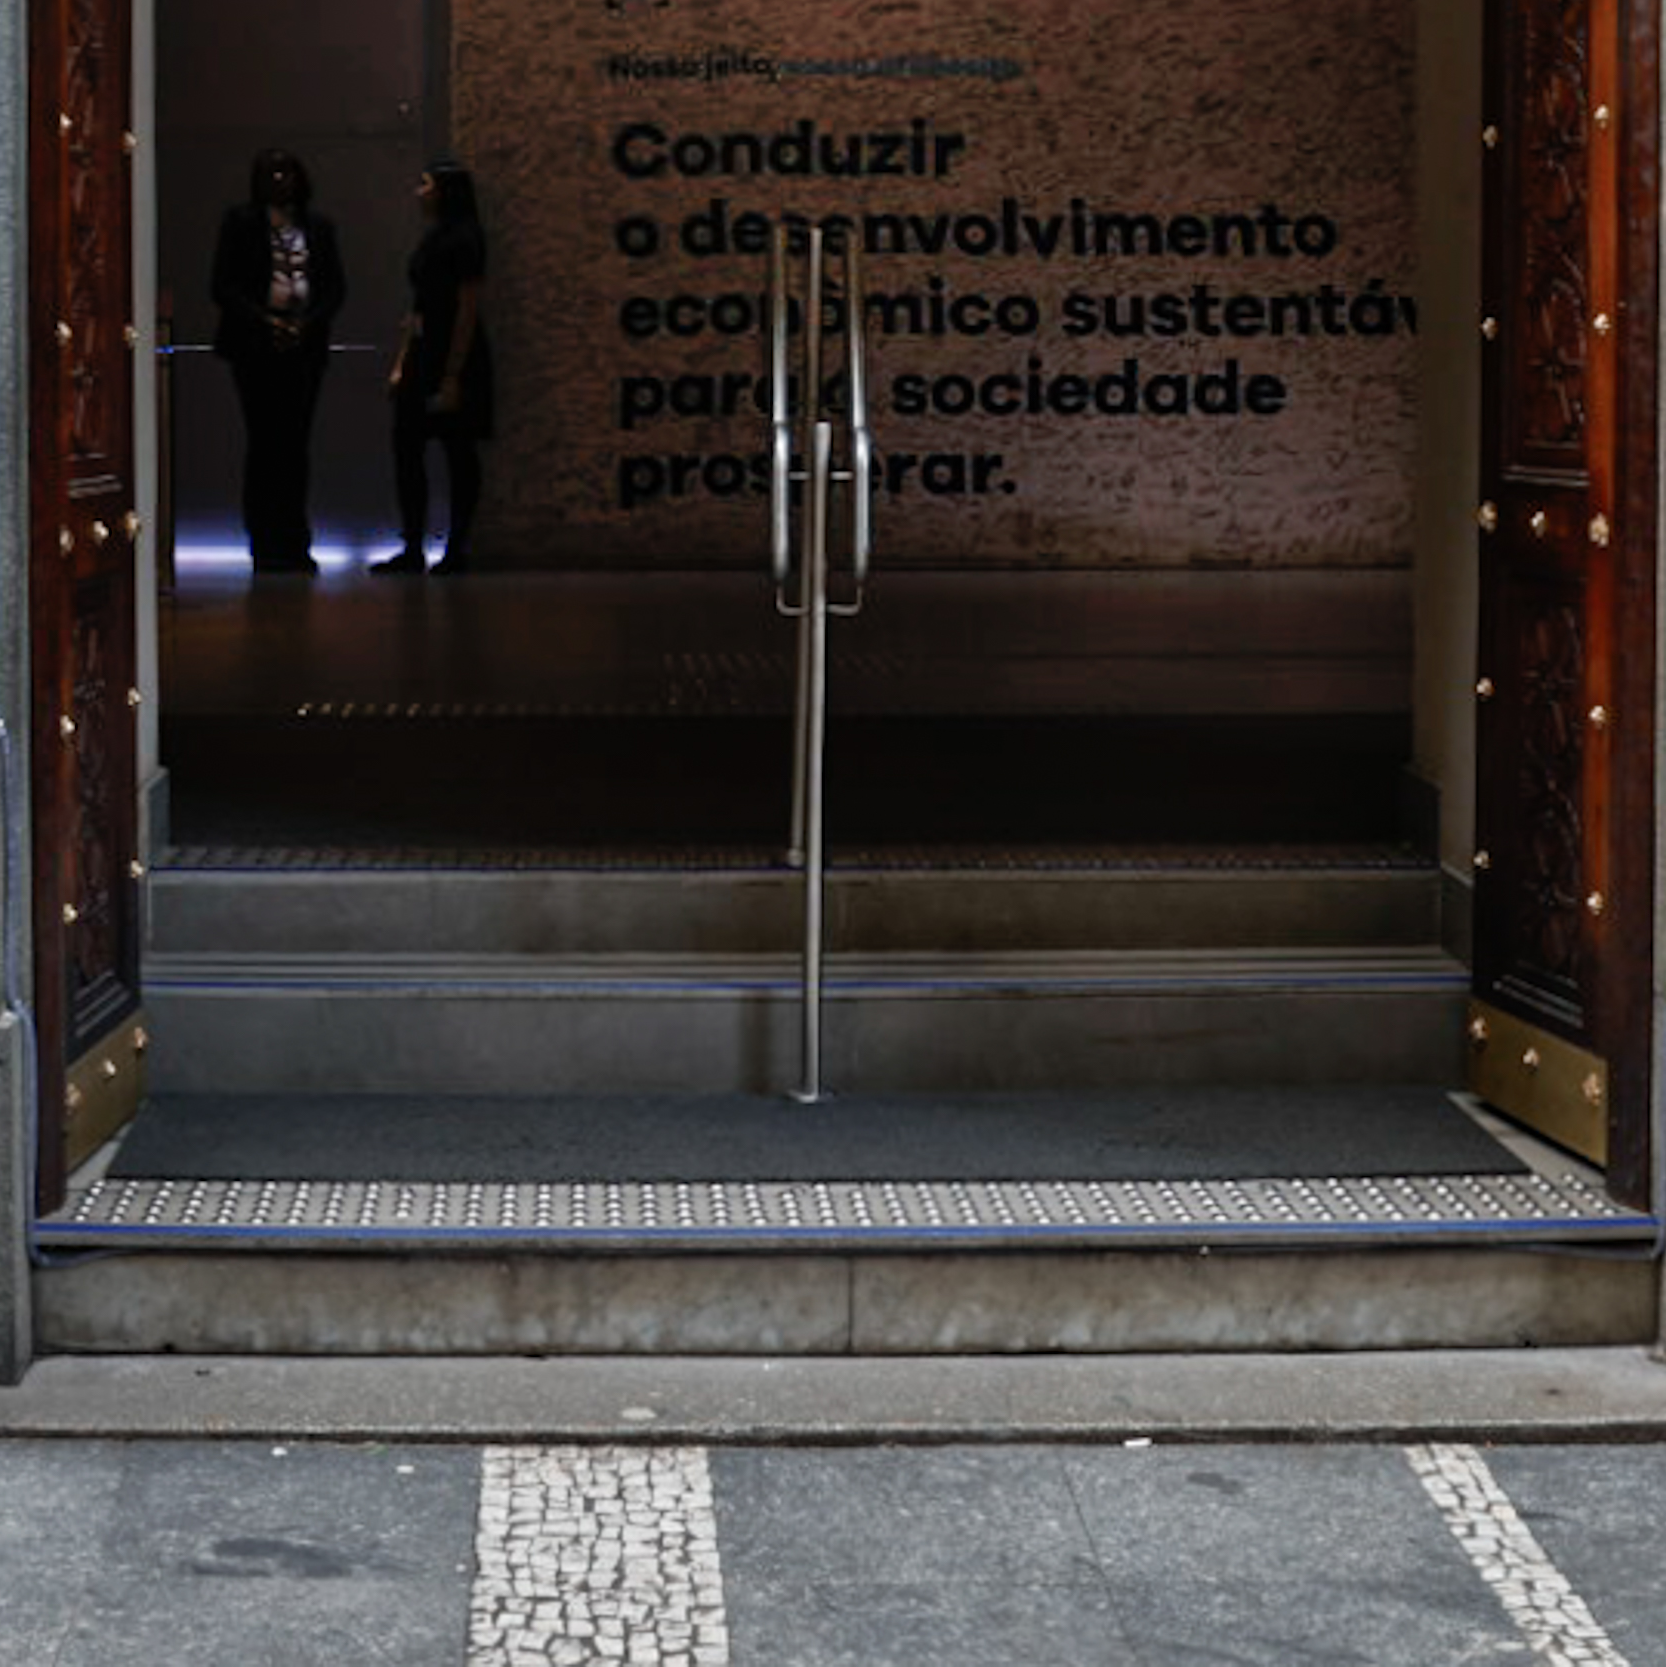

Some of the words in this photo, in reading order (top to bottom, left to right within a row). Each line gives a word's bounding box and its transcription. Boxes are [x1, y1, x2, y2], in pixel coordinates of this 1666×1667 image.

[610, 119, 967, 180] Conduzir
[613, 210, 659, 260] o
[681, 198, 1338, 259] desenvolvimento
[891, 358, 1288, 418] sociedade
[617, 448, 1020, 509] prosrar.
